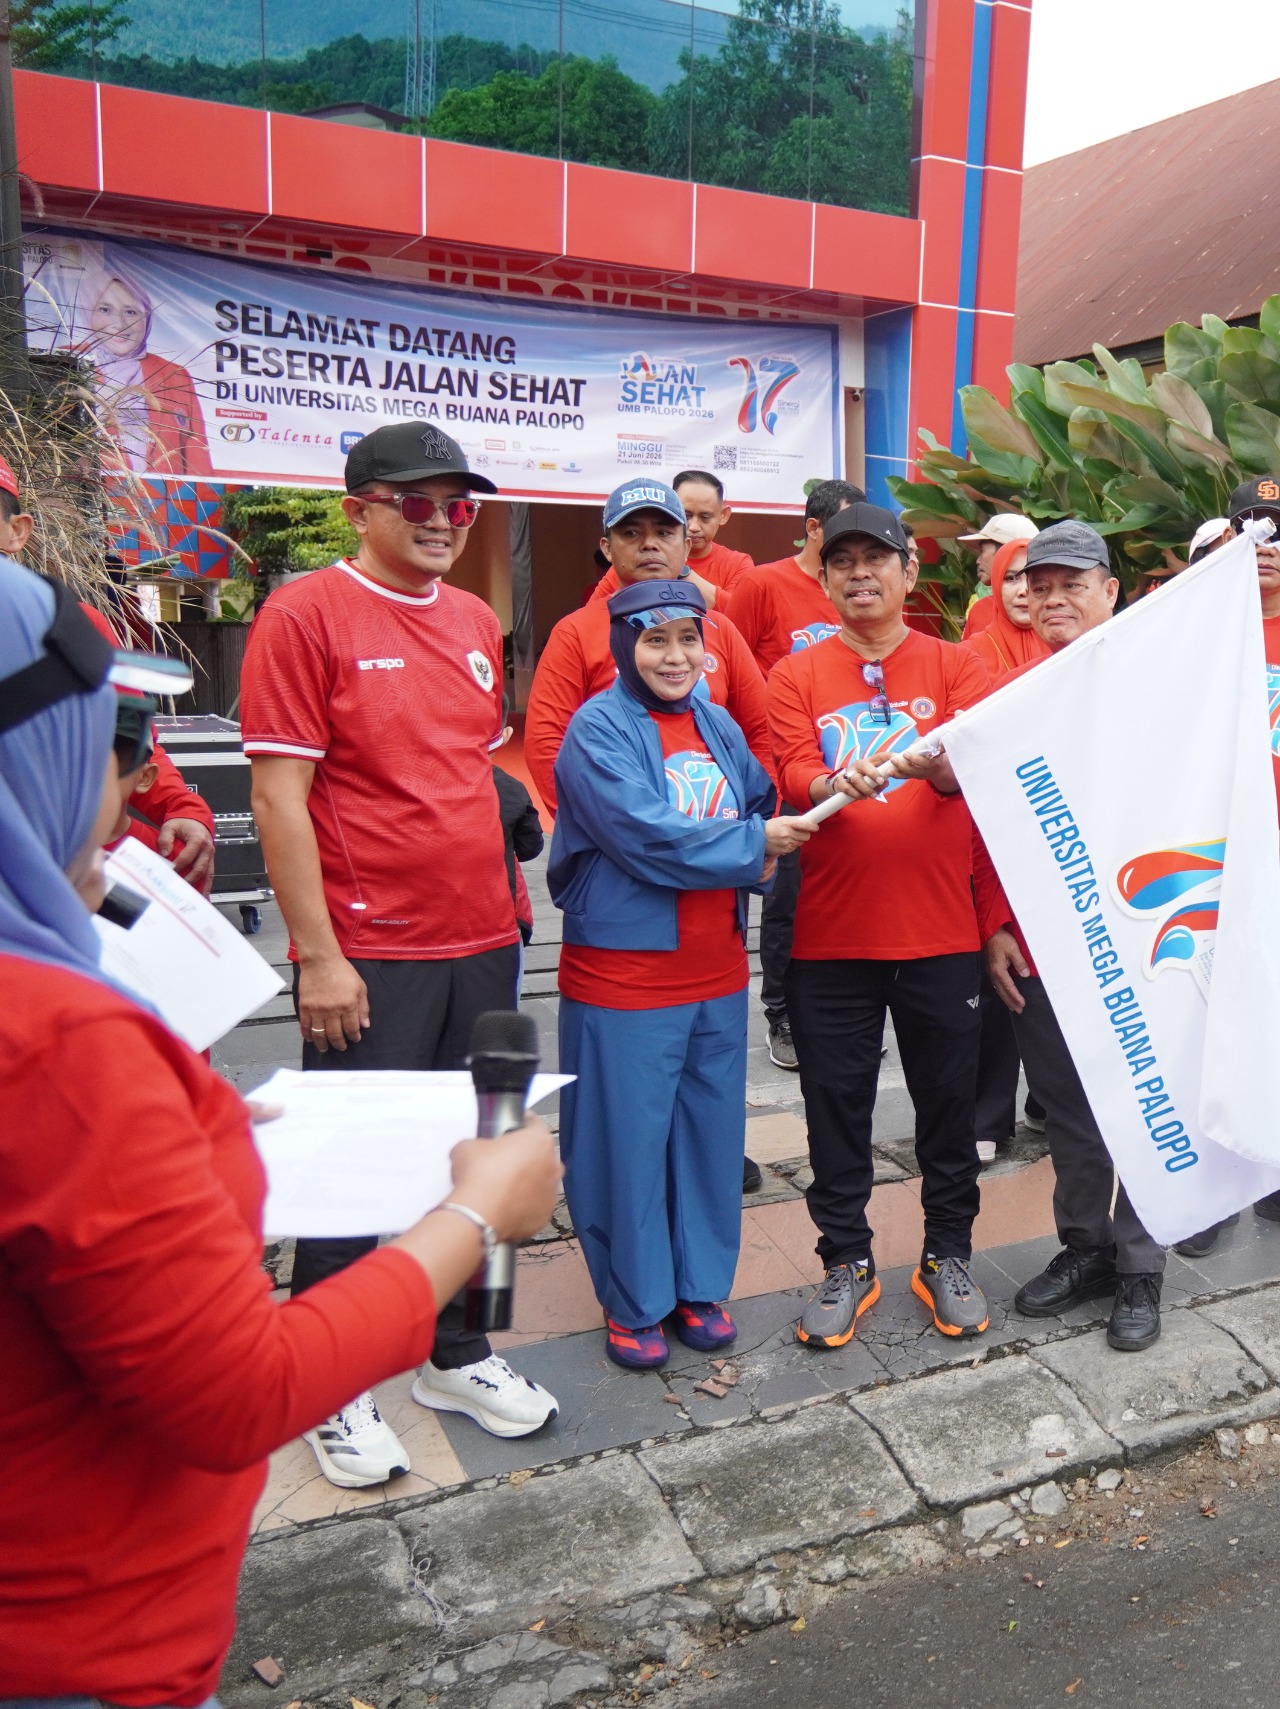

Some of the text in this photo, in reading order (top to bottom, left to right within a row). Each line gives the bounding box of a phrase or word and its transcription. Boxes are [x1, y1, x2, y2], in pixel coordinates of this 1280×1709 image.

[22, 241, 52, 256] SITAS
[215, 299, 517, 365] SELAMAT DATANG
[215, 341, 587, 407] PESERTA JALAN SEHAT
[621, 380, 706, 408] SEHAT
[216, 380, 585, 431] DI UNIVERSITAS MEGA BUANA PALOPO
[220, 409, 262, 420] Supported by
[618, 403, 714, 419] UMB PALOPO 2026
[258, 427, 333, 445] Talenta
[617, 441, 663, 453] MINGGU
[622, 487, 665, 506] MU
[358, 658, 405, 671] erspo
[1015, 755, 1199, 1173] UNIVERSITAS MEGA BUANA PALOPO
